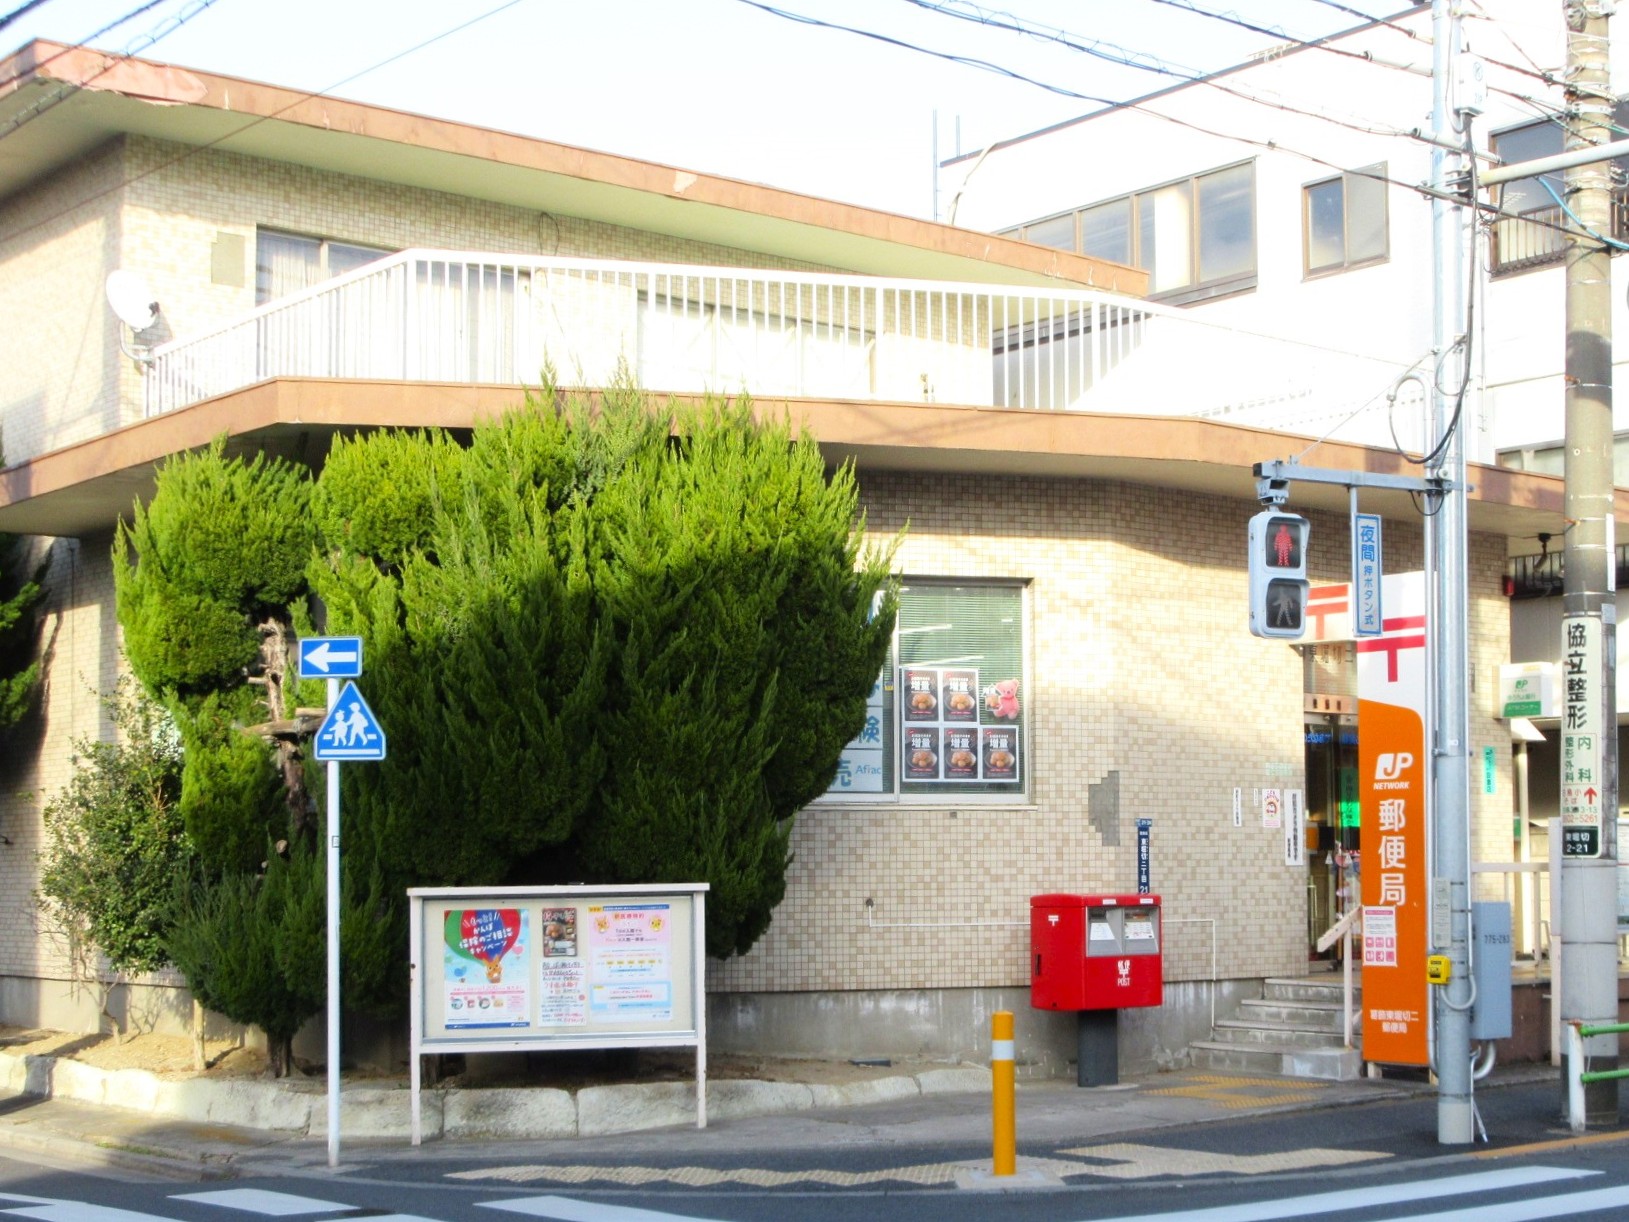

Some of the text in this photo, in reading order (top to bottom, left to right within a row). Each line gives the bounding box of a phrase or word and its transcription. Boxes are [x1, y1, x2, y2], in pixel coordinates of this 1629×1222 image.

[1567, 623, 1587, 729] 協立整形
[1373, 781, 1410, 790] NETWORK
[1566, 843, 1588, 852] 2-21
[1378, 799, 1406, 906] 郵便局
[1117, 978, 1131, 987] POST
